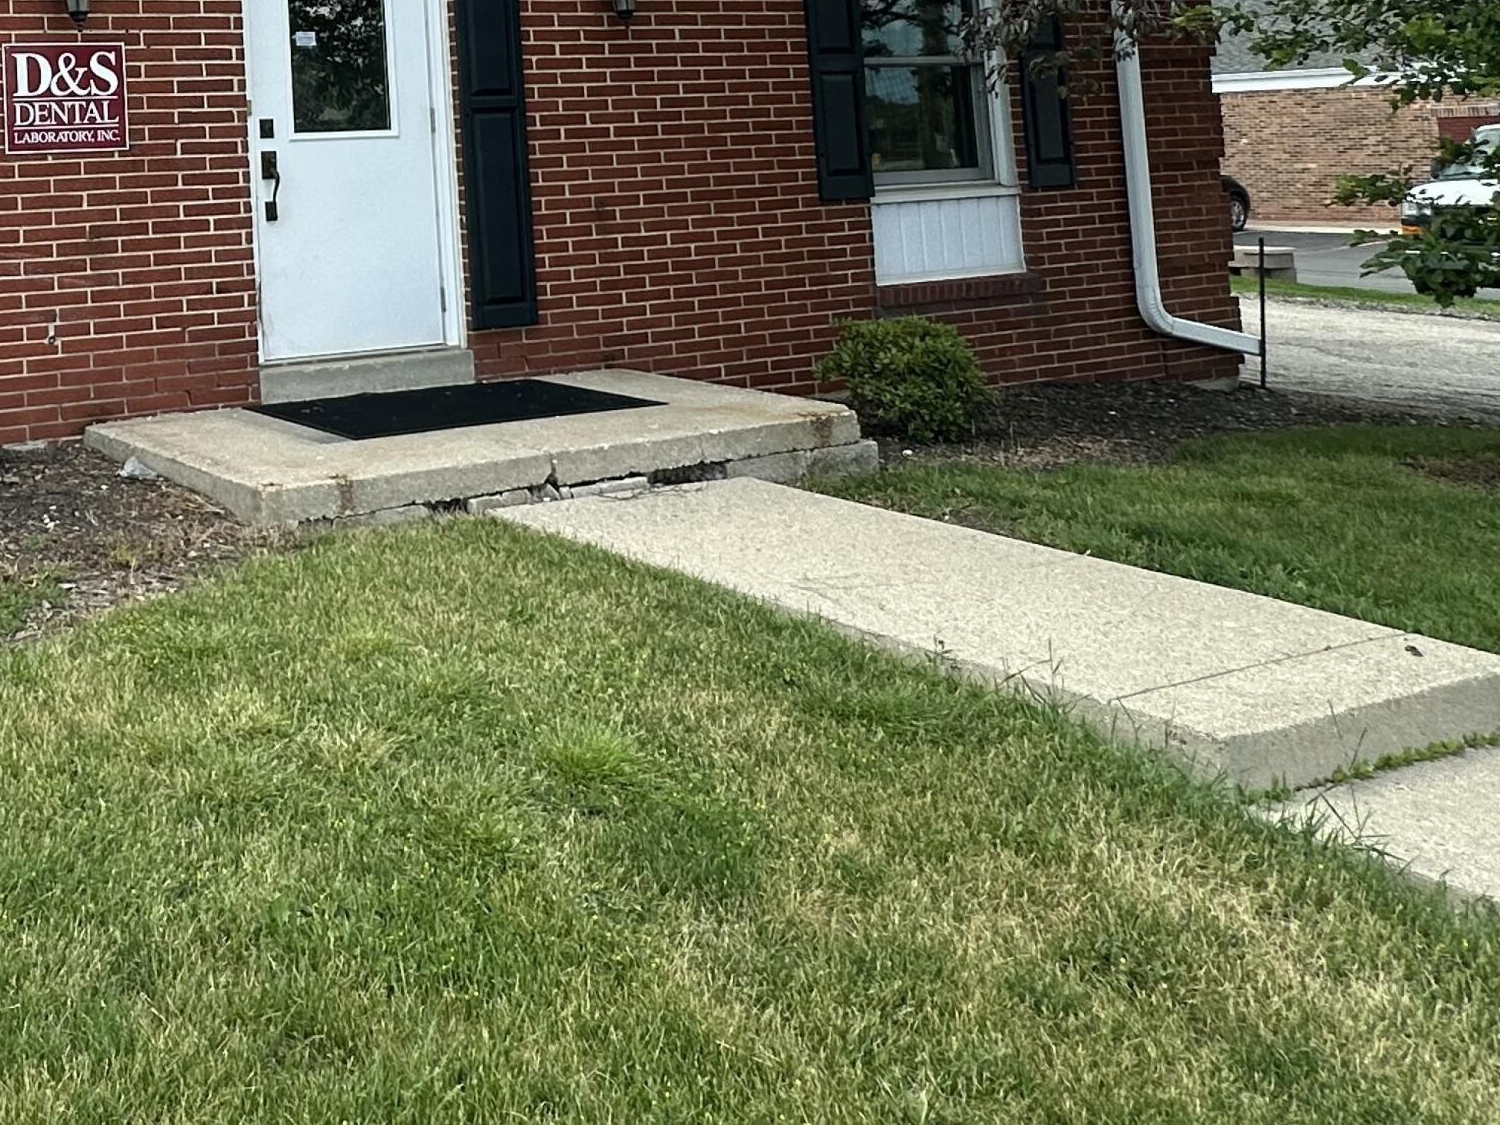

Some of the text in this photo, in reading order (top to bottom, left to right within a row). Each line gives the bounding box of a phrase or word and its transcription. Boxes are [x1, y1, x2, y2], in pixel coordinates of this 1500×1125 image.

[11, 51, 119, 97] D&S
[13, 100, 119, 126] DENTAL
[14, 129, 121, 144] LABORATORY, INC.
